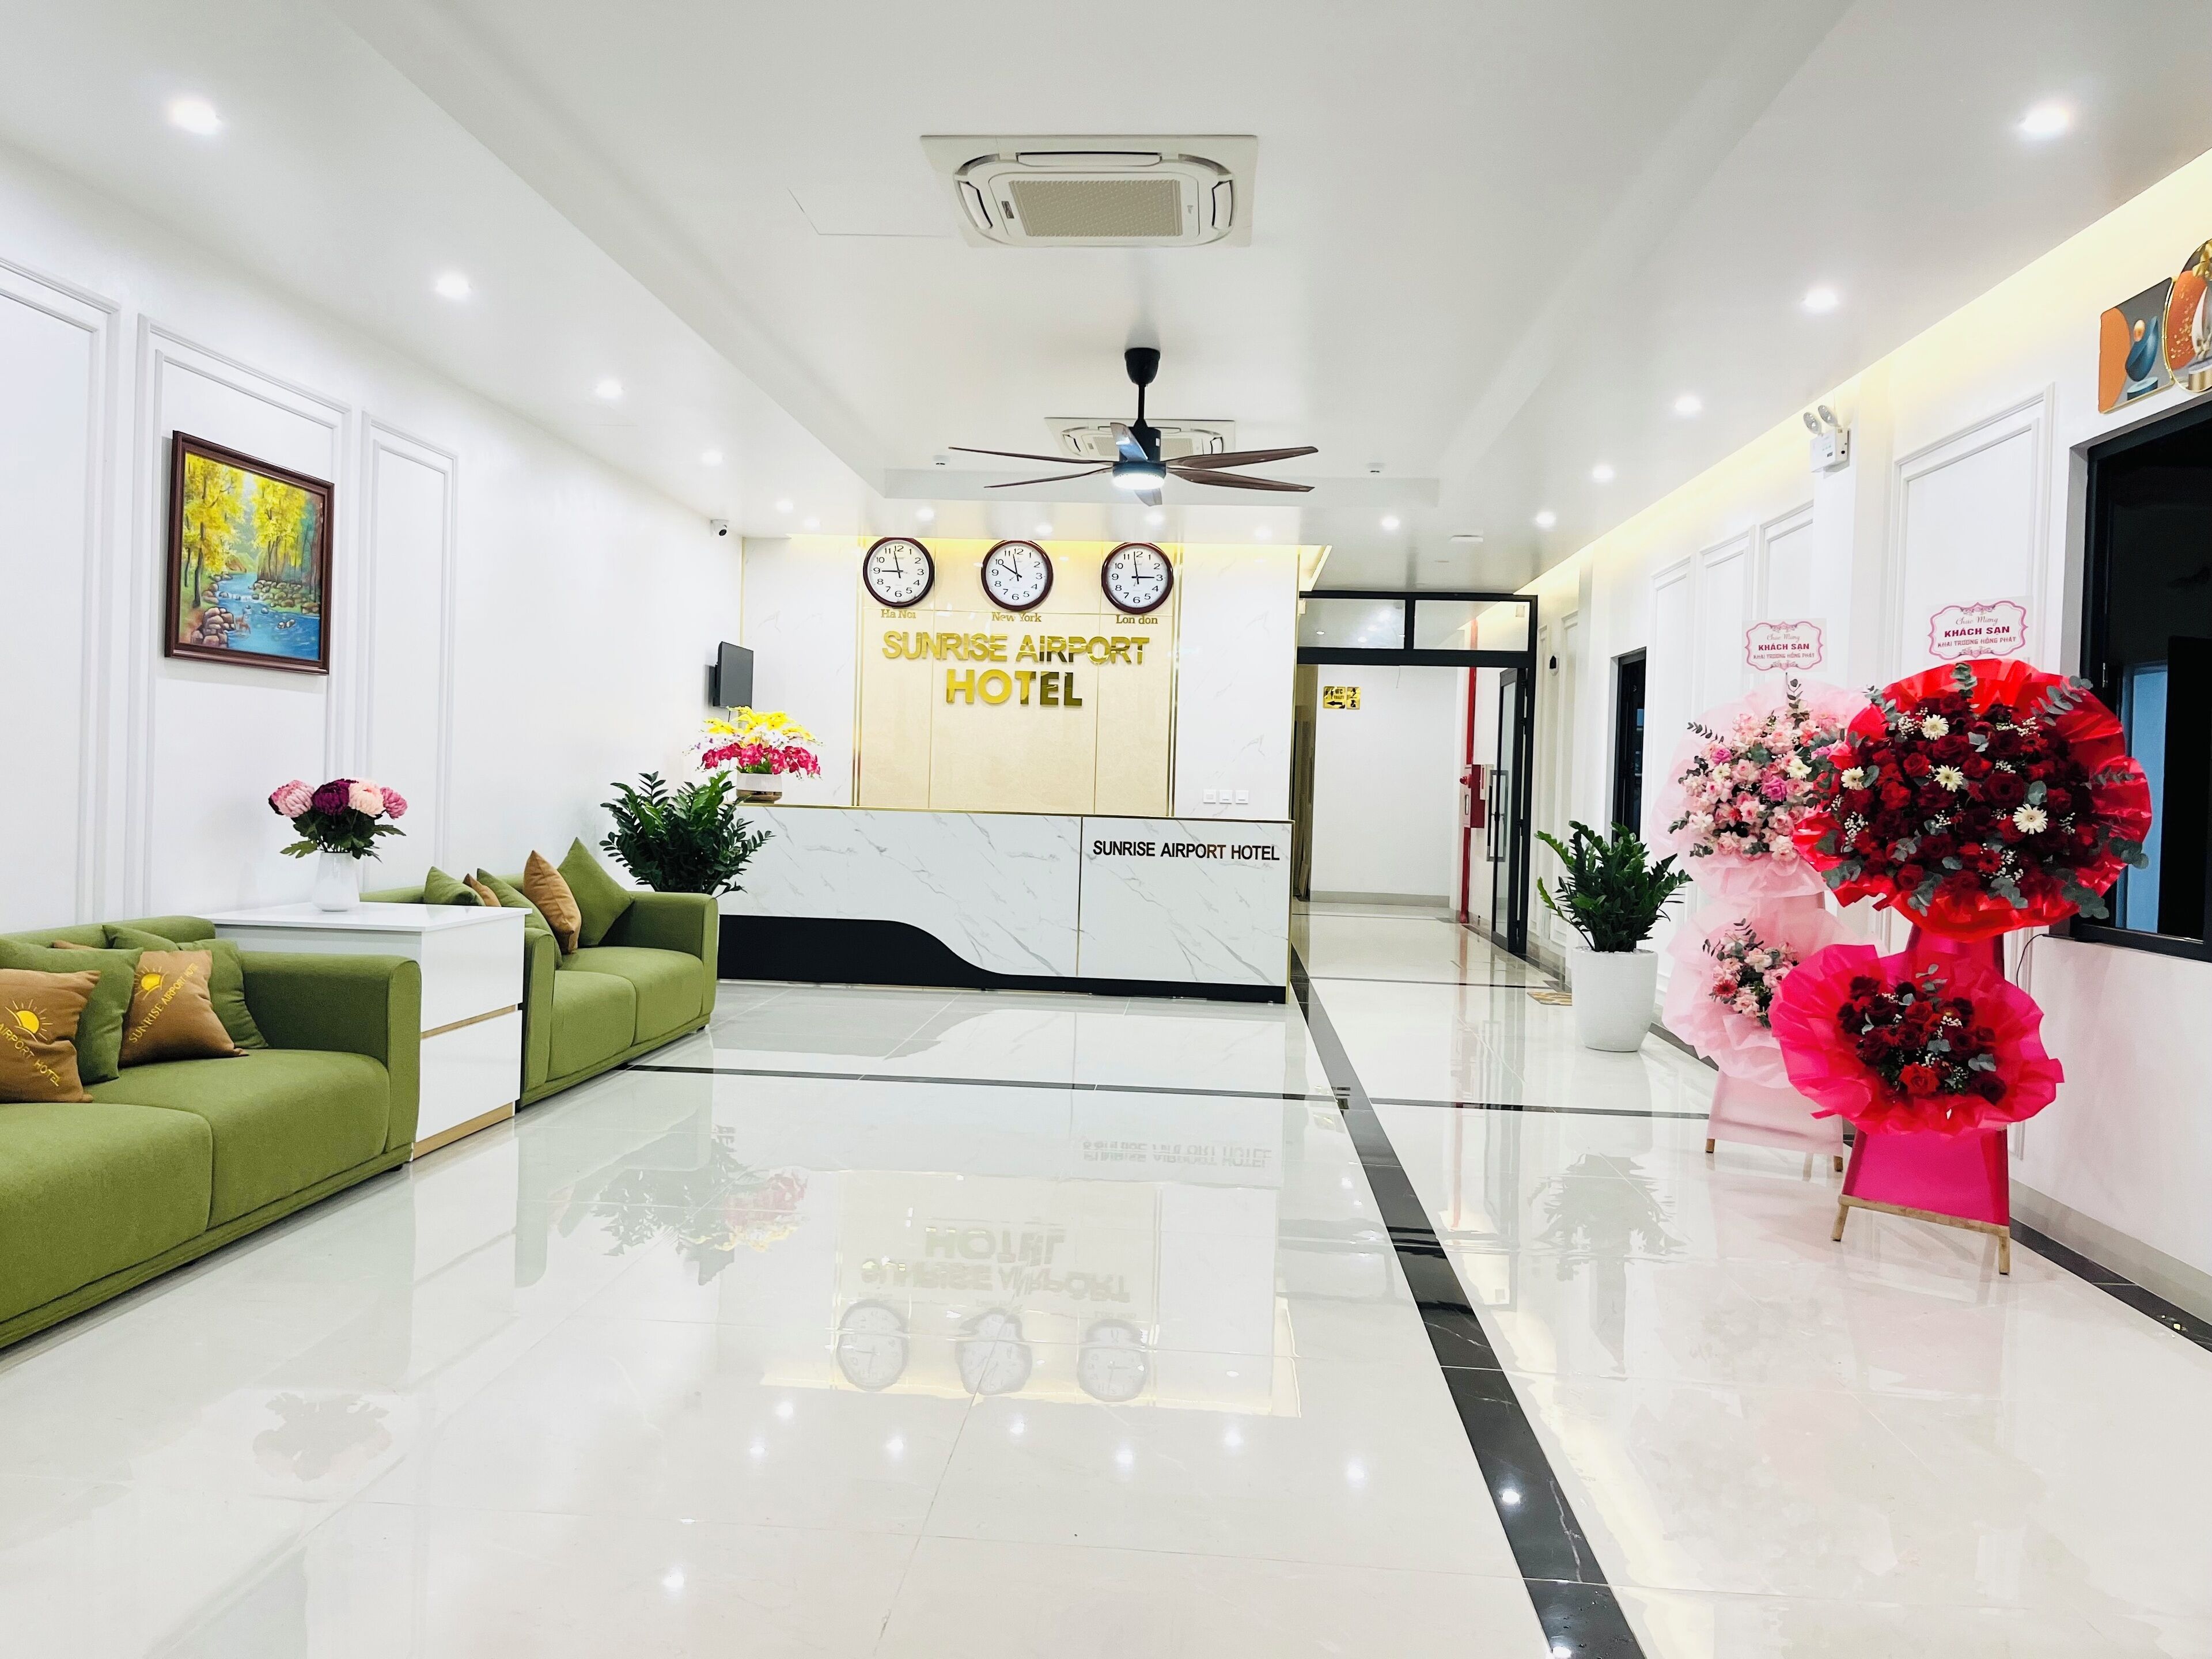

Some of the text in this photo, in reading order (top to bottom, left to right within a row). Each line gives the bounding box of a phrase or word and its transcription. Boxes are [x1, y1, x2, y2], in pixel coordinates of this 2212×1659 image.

[991, 611, 1042, 622] New York
[1944, 627, 1982, 638] KHÁCH
[882, 631, 1150, 665] SUNRISE AIRPORT
[1758, 643, 1788, 651] KHÁCH
[946, 669, 1082, 706] HOTEL
[1093, 840, 1280, 861] SUNRISE AIRPORT HOTEL
[128, 1003, 162, 1043] SUNRISE
[161, 976, 186, 1005] AIRPORT
